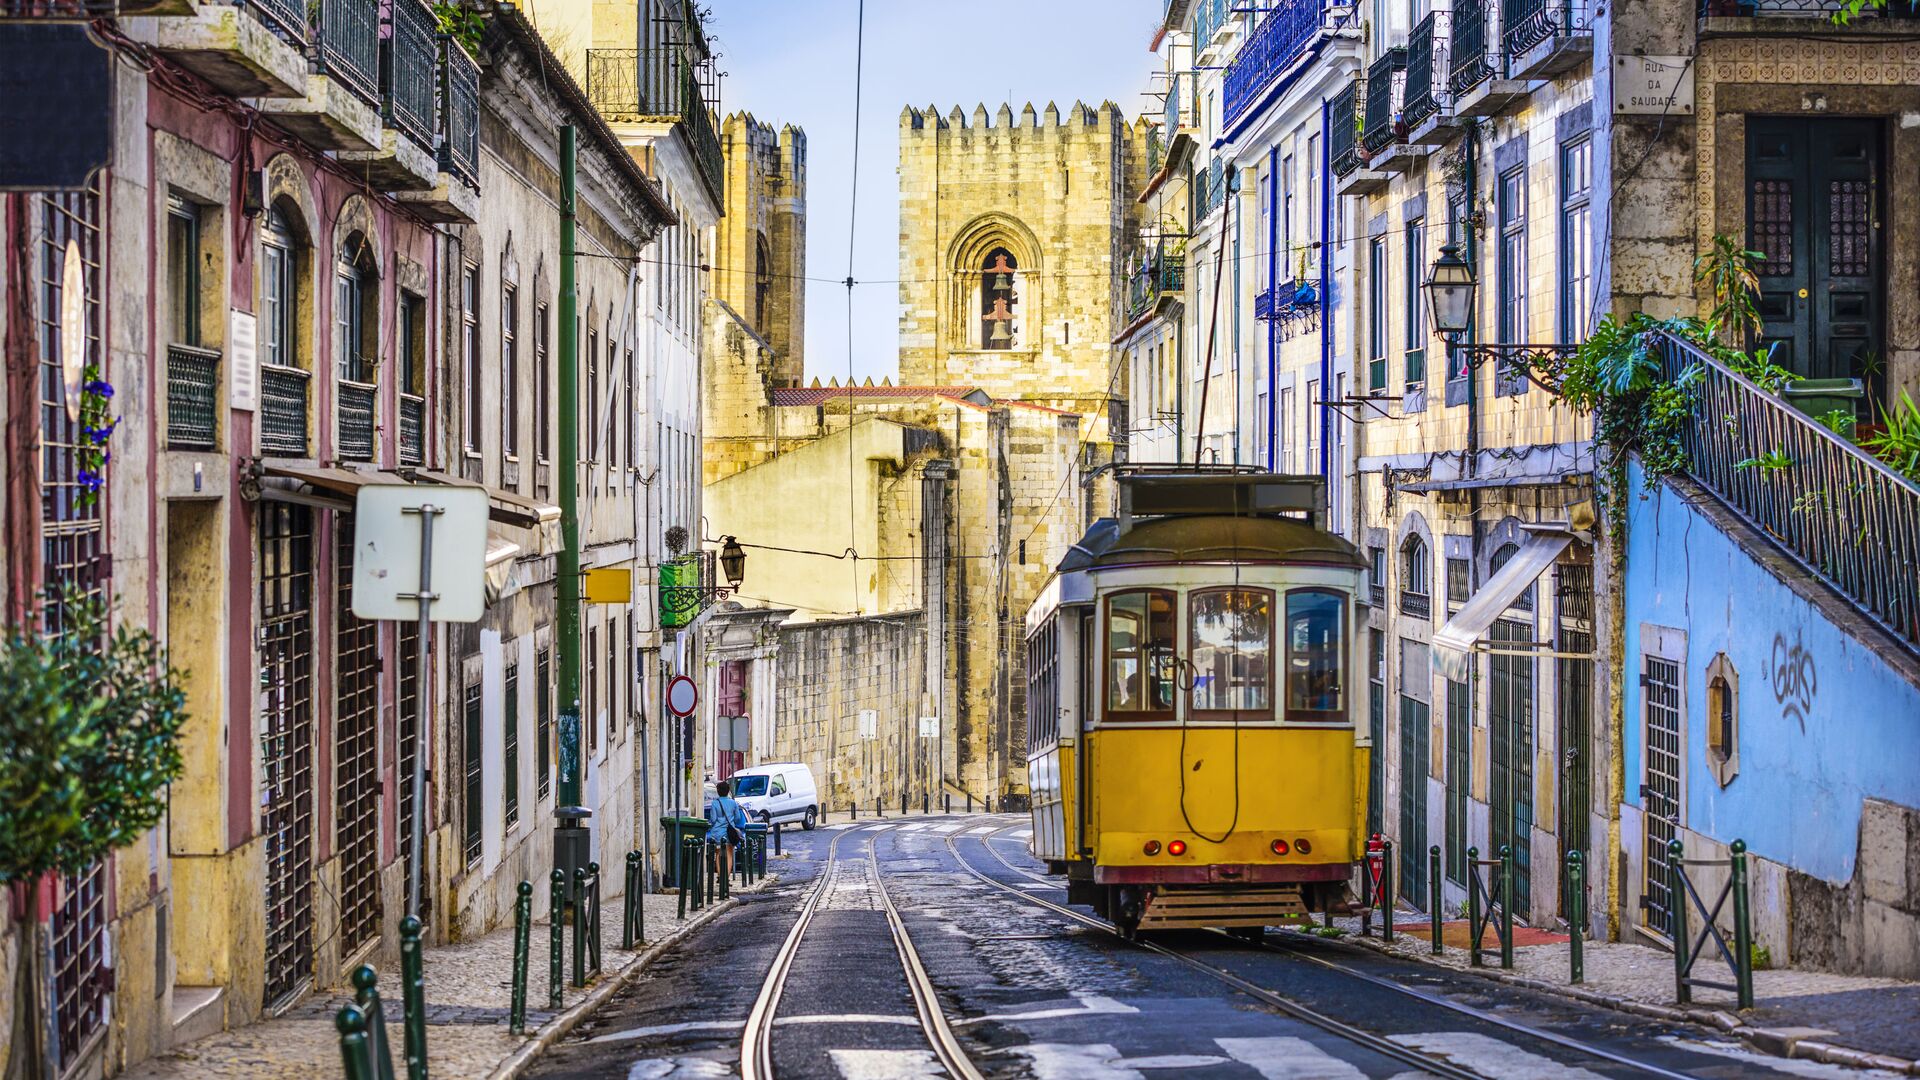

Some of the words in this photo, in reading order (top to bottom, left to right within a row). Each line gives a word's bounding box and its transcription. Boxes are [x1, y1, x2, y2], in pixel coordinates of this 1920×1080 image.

[1645, 64, 1664, 72] RUA
[1648, 80, 1660, 89] DA
[1631, 97, 1677, 106] SAUDADE
